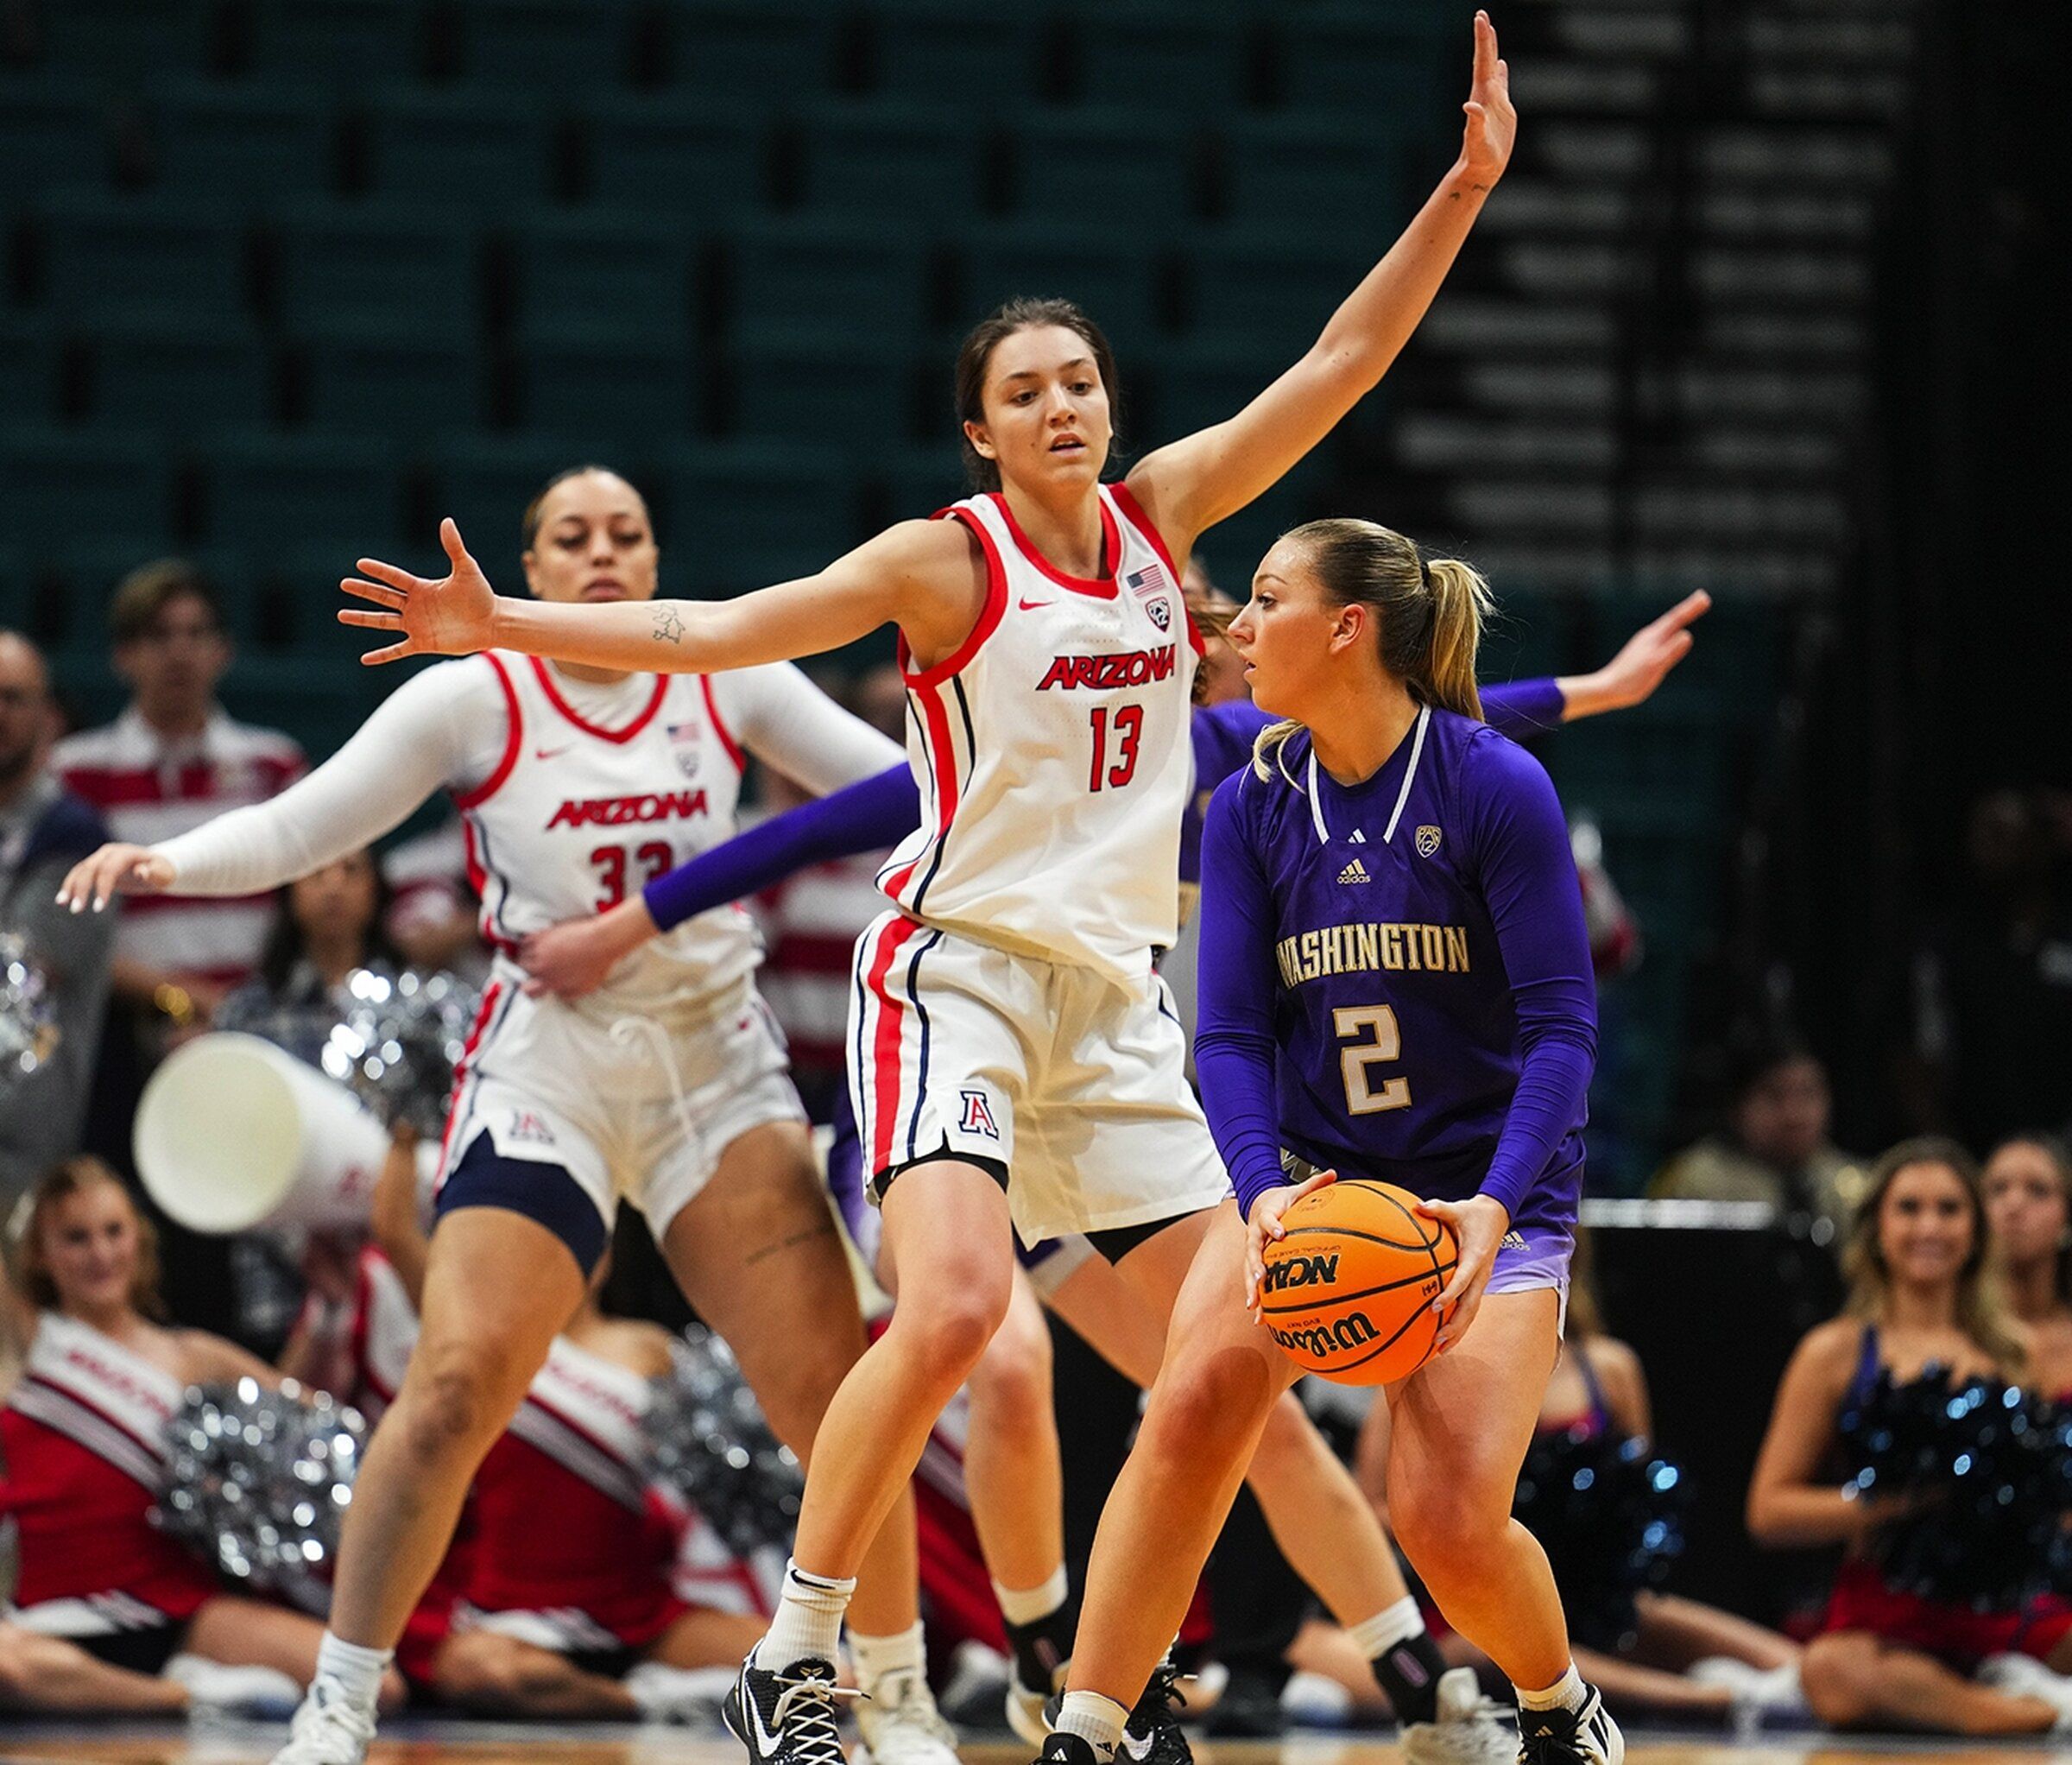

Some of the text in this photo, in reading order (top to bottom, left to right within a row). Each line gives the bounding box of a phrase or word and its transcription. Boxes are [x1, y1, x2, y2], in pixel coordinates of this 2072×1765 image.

[1035, 643, 1176, 691] ARIZONA
[1090, 704, 1144, 793] 13
[546, 788, 708, 831] ARIZONA
[1337, 875, 1371, 885] adidas
[1276, 922, 1471, 990] WASHINGTON
[1332, 1003, 1412, 1116] 2
[958, 1091, 999, 1141] A
[1266, 1312, 1381, 1357] Wilson
